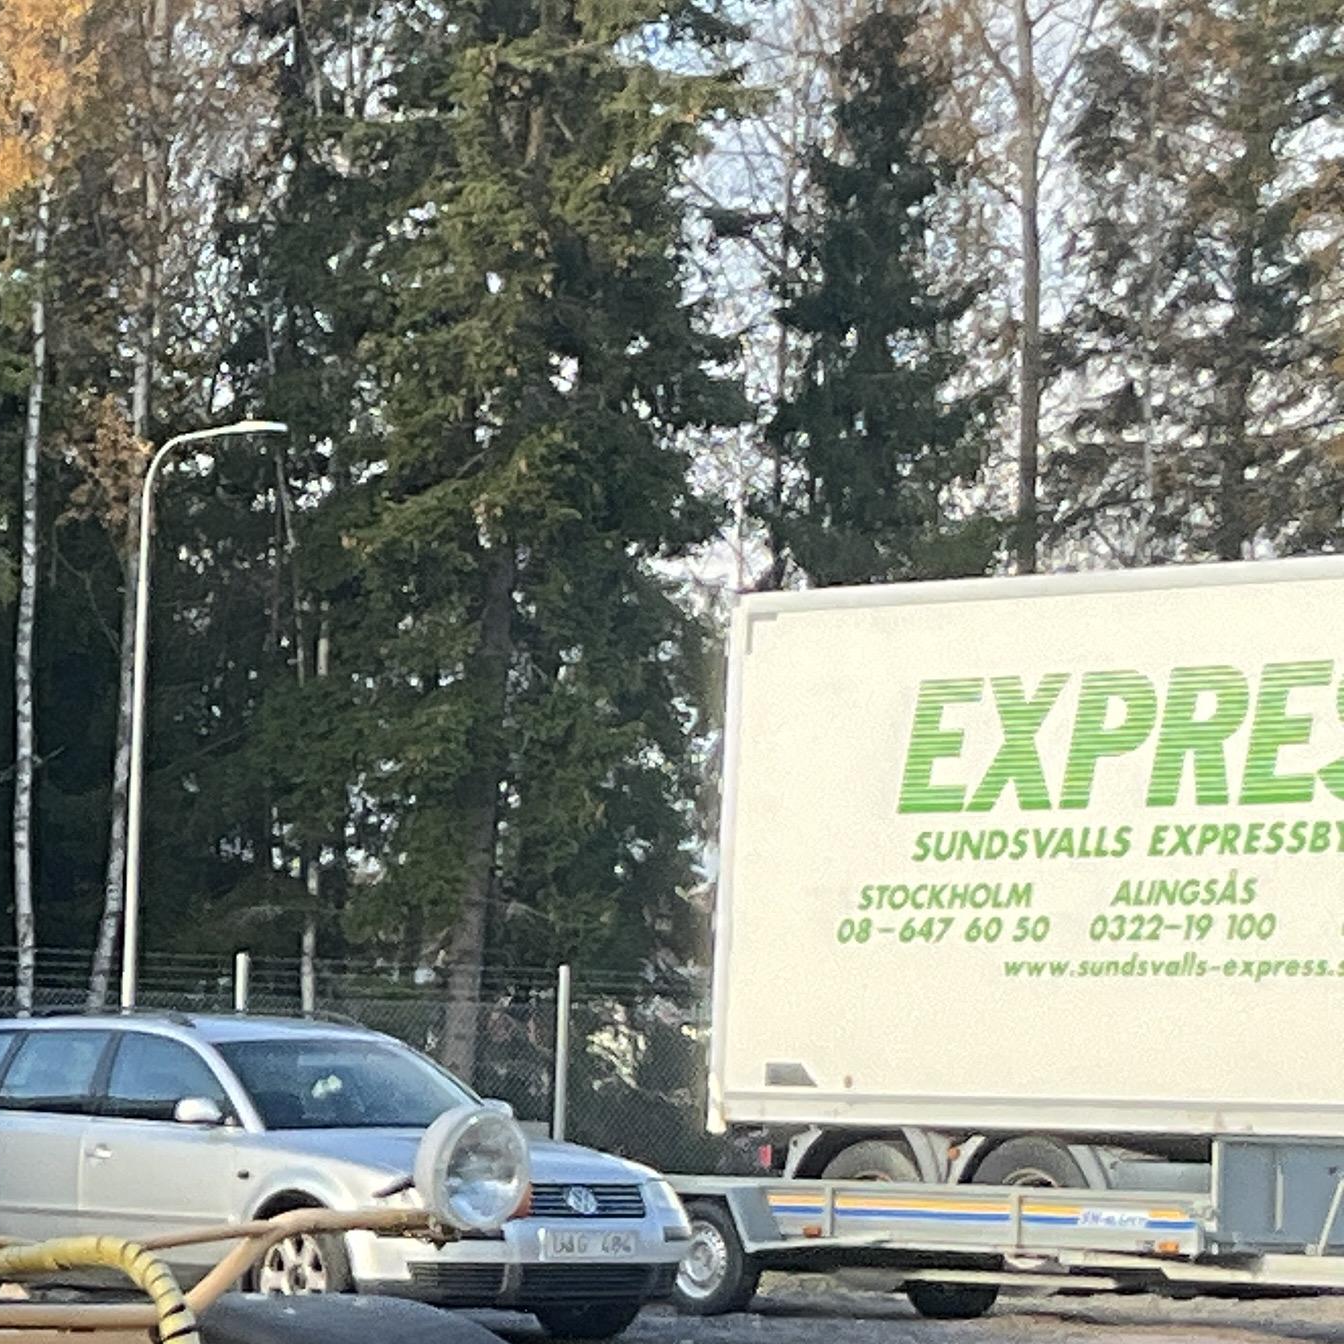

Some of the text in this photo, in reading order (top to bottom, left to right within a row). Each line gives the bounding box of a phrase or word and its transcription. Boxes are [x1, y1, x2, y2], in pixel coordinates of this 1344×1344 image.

[912, 825, 1132, 861] SUNDSVALLS
[857, 882, 1033, 910] STOCKHOLM
[1109, 868, 1259, 906] ALINGSÅS
[837, 915, 1050, 943] 08-647 60 50
[1089, 912, 1277, 941] 0322-19 100
